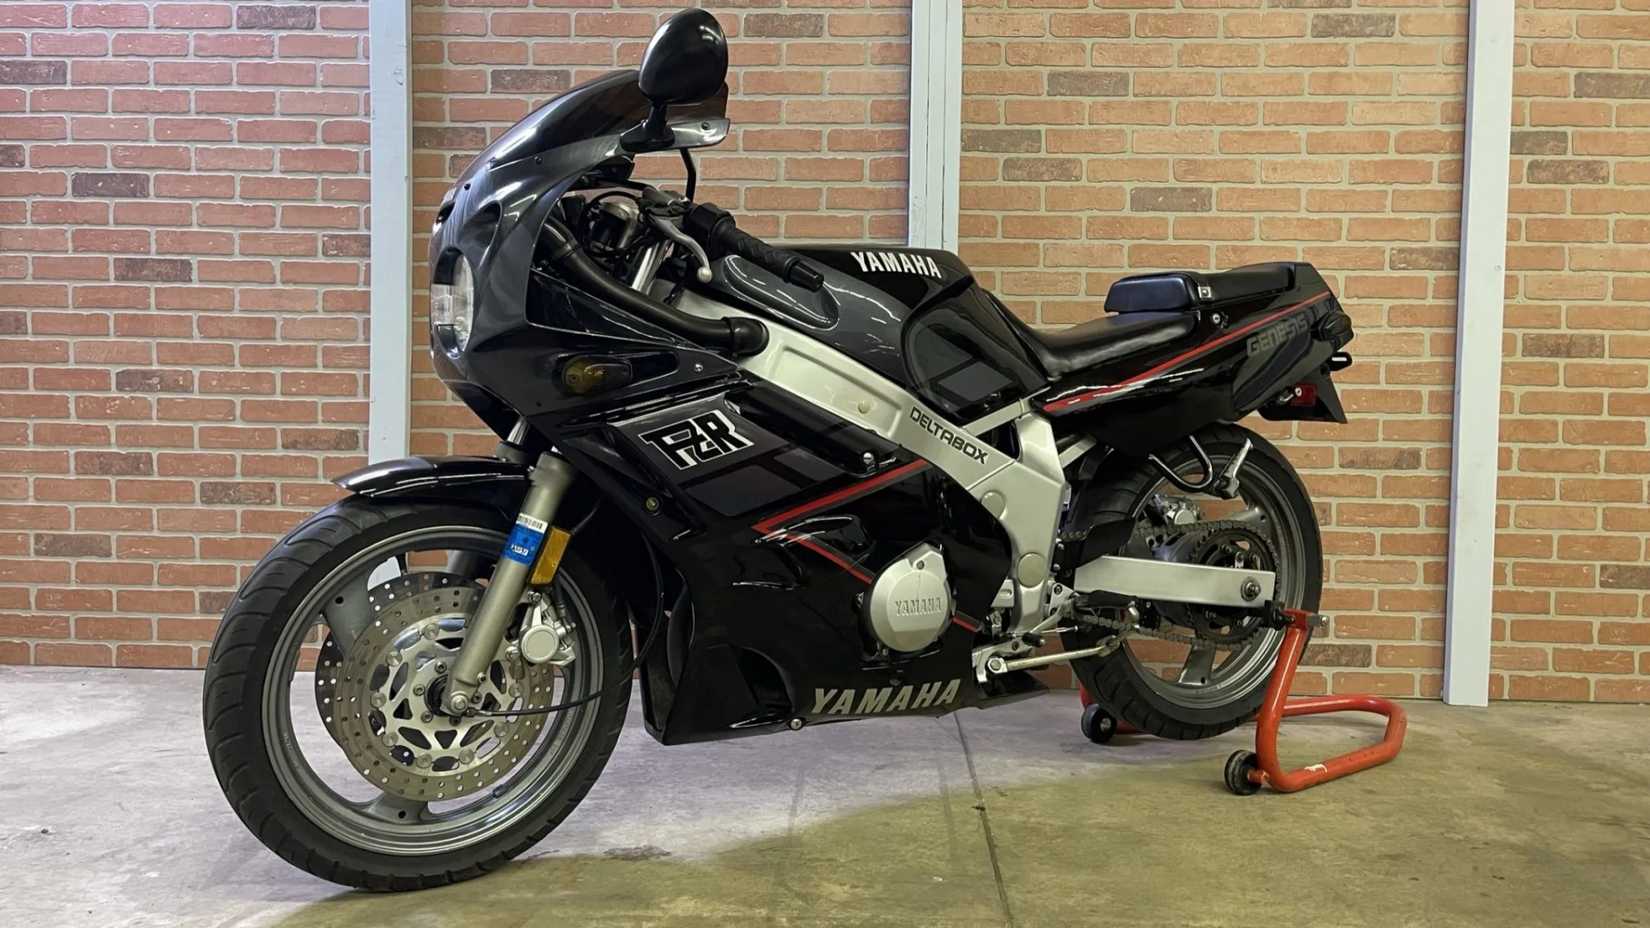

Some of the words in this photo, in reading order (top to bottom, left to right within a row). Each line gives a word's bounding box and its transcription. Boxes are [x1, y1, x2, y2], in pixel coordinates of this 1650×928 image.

[850, 251, 942, 279] YAMAHA
[1246, 312, 1309, 356] GENESIS
[638, 409, 755, 470] FZR
[910, 406, 988, 465] DELTABOX
[895, 596, 942, 616] YAMAHA
[811, 678, 961, 715] YAMAHA
